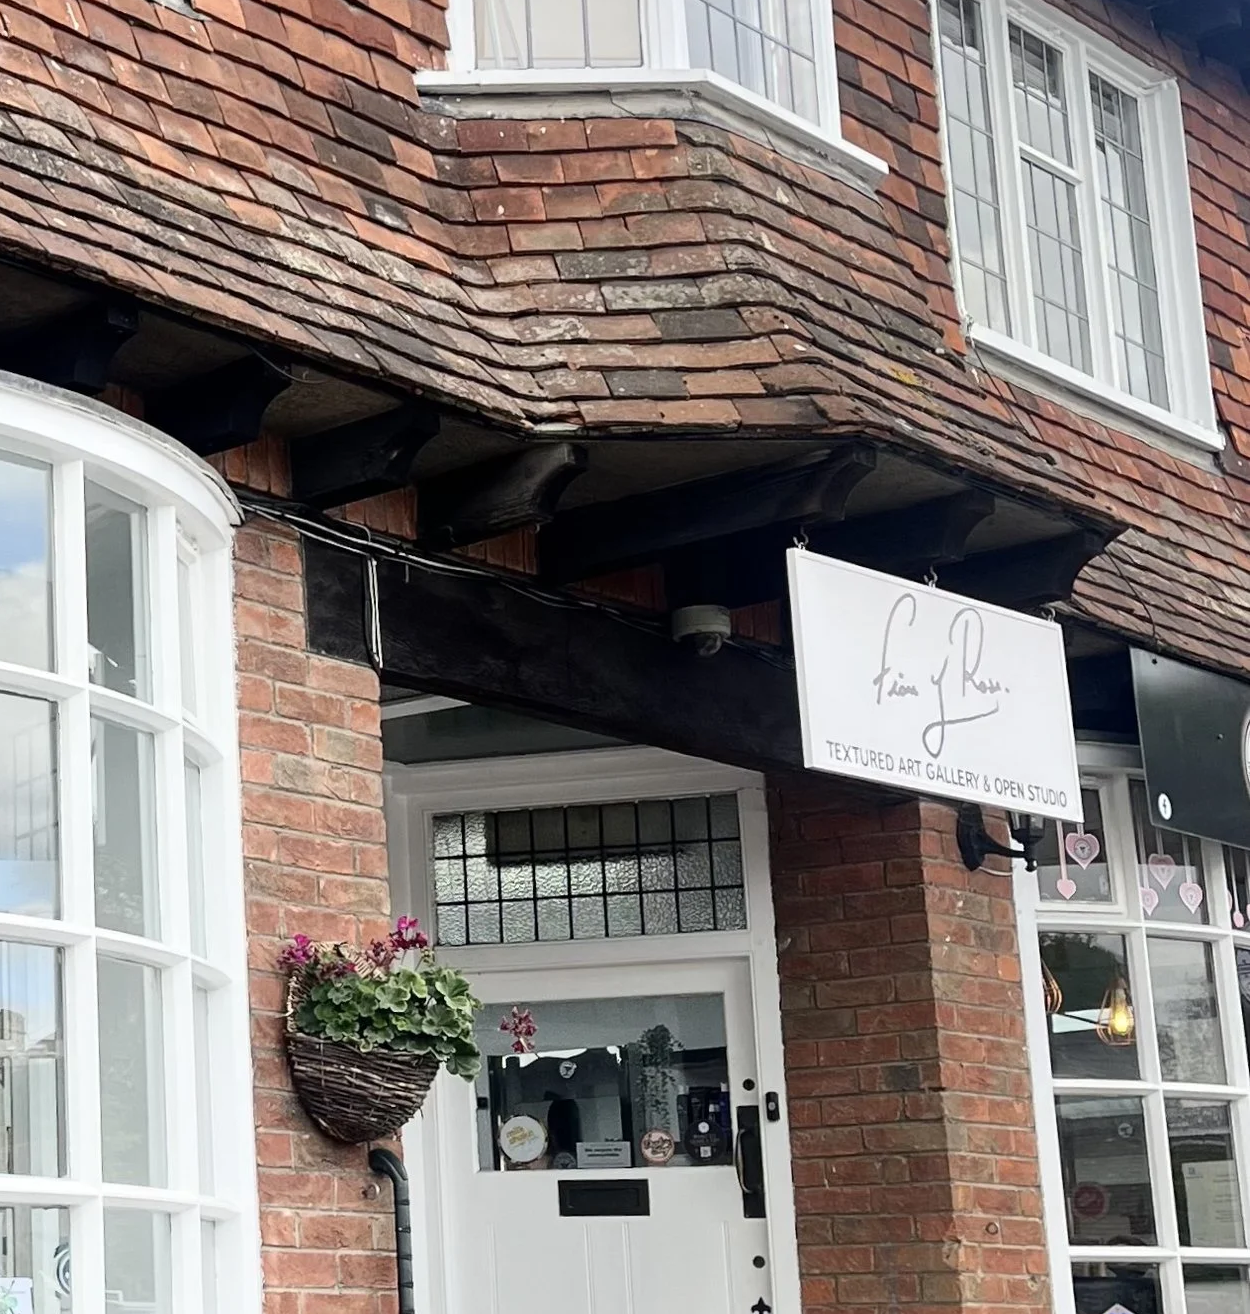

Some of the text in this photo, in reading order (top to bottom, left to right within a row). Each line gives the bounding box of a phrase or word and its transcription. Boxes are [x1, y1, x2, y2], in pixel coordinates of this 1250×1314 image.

[825, 739, 1068, 808] TEXTURED ART GALLERY & OPEN STUDIO
